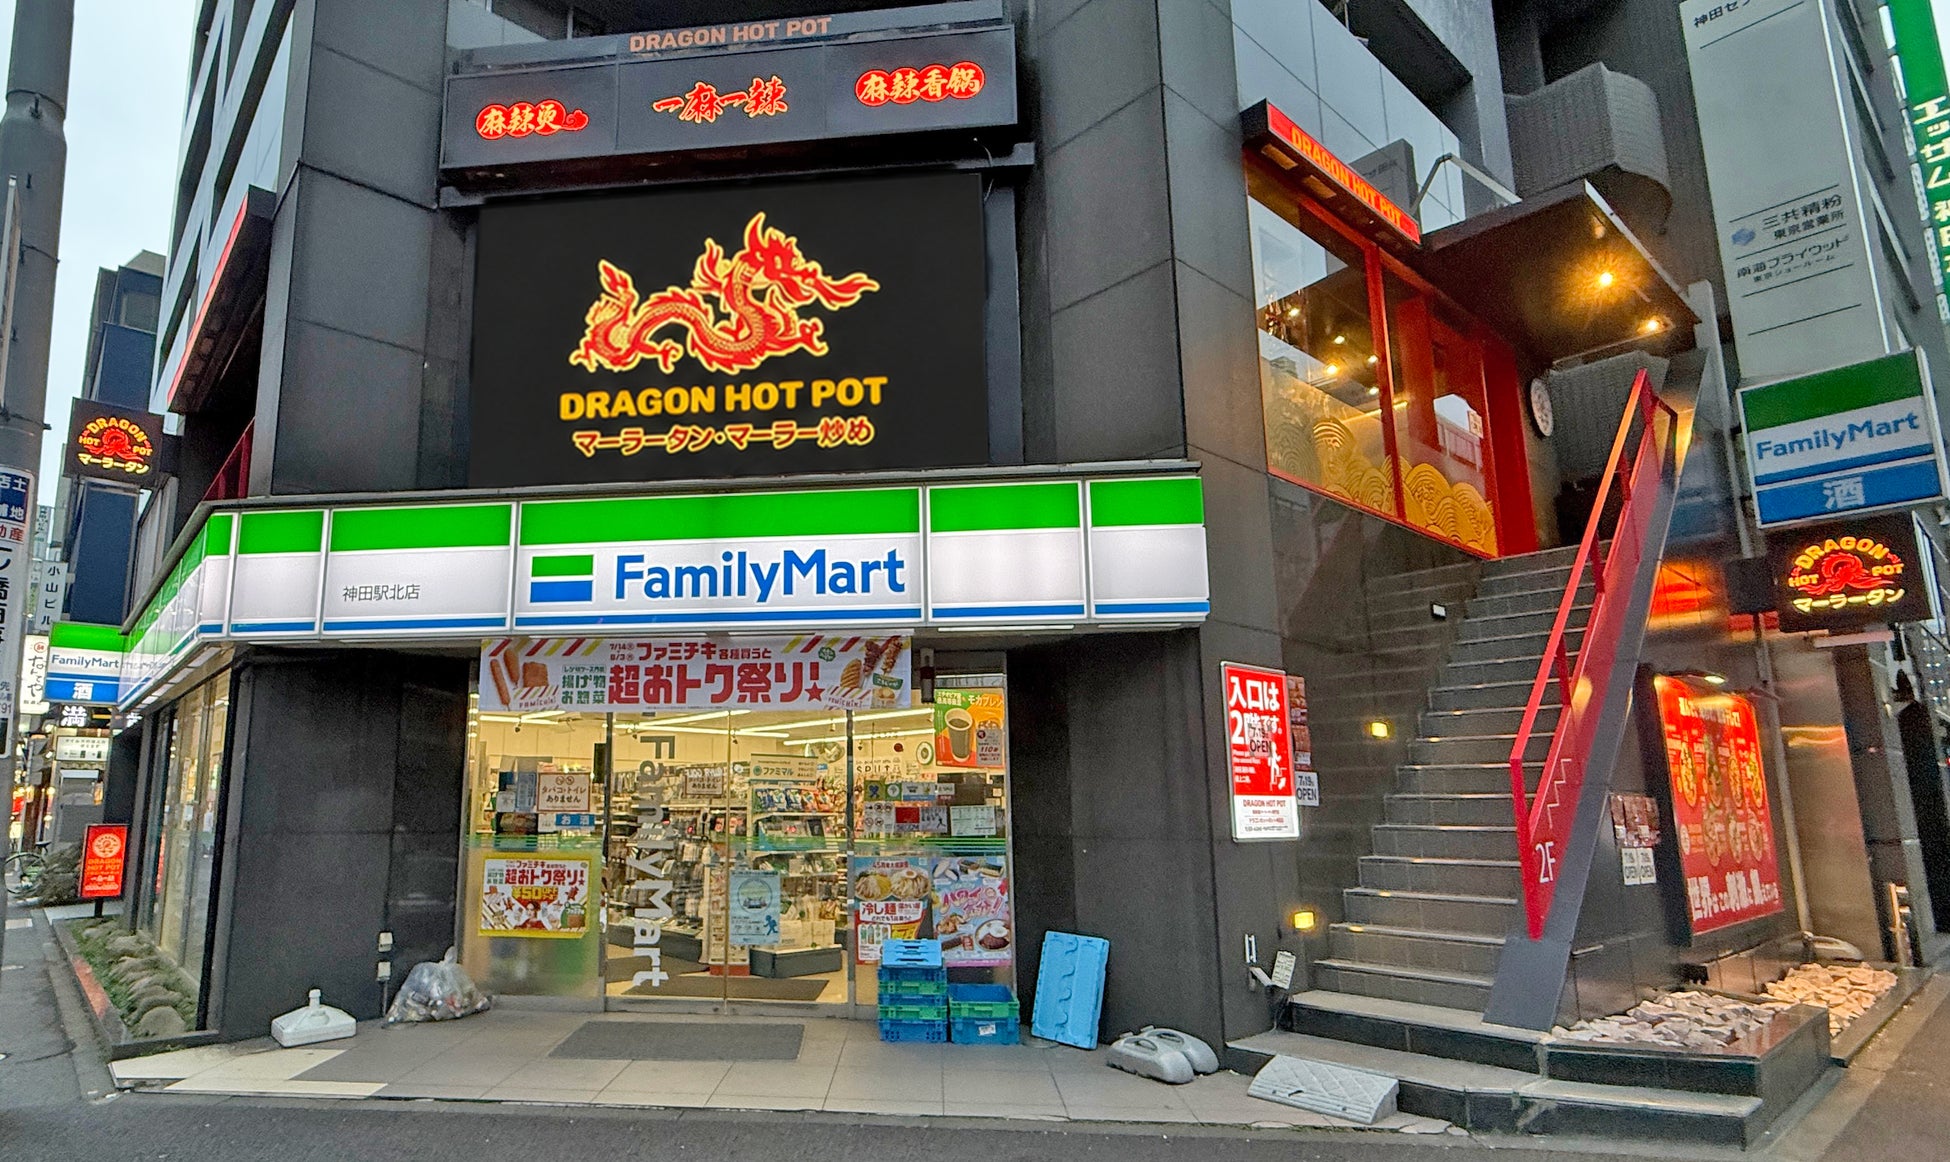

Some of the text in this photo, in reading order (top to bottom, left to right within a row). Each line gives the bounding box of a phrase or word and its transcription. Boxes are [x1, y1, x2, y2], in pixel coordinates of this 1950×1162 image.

[1694, 0, 1752, 28] 神田セ
[629, 17, 832, 53] DRAGON HOT POT
[1291, 126, 1349, 186] DRAGON
[1352, 179, 1377, 207] HOT
[1379, 199, 1402, 223] POT
[1774, 209, 1845, 240] 東京営業所
[1736, 235, 1849, 279] 南海プライウッド
[559, 376, 888, 421] DRAGON HOT POT
[87, 417, 148, 443] DRAGON
[1757, 411, 1920, 460] FamilyMart
[78, 436, 154, 457] HOT POT
[77, 452, 150, 475] マーラータン
[1822, 476, 1866, 511] 酒
[1795, 536, 1889, 570] DRAGON
[615, 547, 905, 604] FamilyMart
[1788, 563, 1905, 588] HOT POT
[342, 584, 421, 602] 神田駅北店
[1792, 588, 1905, 613] マーラータン
[51, 654, 119, 669] FamilyMart
[637, 642, 717, 661] ファミチキ
[72, 682, 94, 700] 酒
[562, 674, 606, 689] 揚げ物
[1229, 676, 1280, 711] 入口は
[562, 691, 605, 704] お惣菜
[546, 795, 581, 803] ありません
[1296, 787, 1317, 801] OPEN
[626, 735, 676, 988] FamilyMart
[1535, 841, 1556, 884] 2F
[862, 902, 896, 915] 冷し麺
